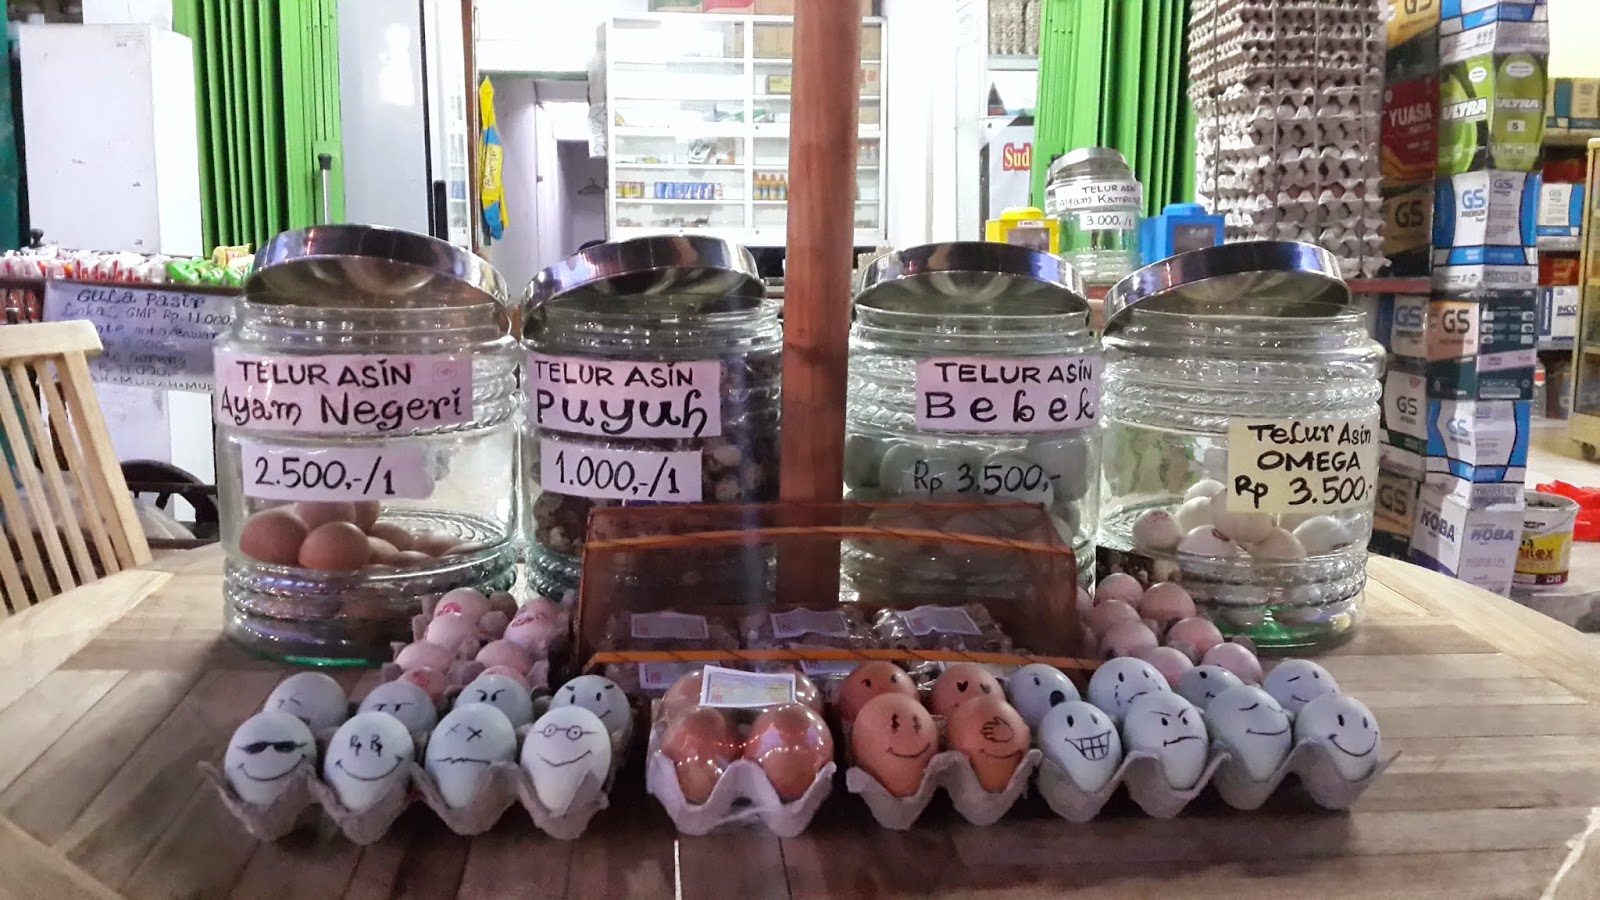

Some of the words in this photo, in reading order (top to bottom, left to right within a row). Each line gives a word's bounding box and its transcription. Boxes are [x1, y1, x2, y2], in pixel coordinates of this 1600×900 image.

[1387, 102, 1433, 127] YUASA
[1442, 98, 1488, 119] ULTRA
[1081, 185, 1118, 195] TELUR
[1493, 178, 1514, 189] GS
[1462, 188, 1485, 209] GS
[1395, 200, 1424, 229] GS
[1461, 209, 1486, 218] PREMIUM
[1396, 304, 1423, 327] GS
[1442, 308, 1470, 334] GS
[236, 360, 329, 387] TELUR
[534, 360, 615, 387] TELUR
[934, 361, 1042, 384] TELUR
[220, 387, 302, 426] Ayam
[320, 388, 464, 431] Negeri
[536, 389, 708, 438] Puyuh
[1397, 395, 1418, 416] GS
[1337, 421, 1372, 446] Asin
[1448, 417, 1470, 437] GS
[1257, 450, 1361, 472] OMEGA
[914, 459, 943, 495] Rp
[1234, 474, 1269, 509] Rp
[1378, 484, 1407, 516] GS
